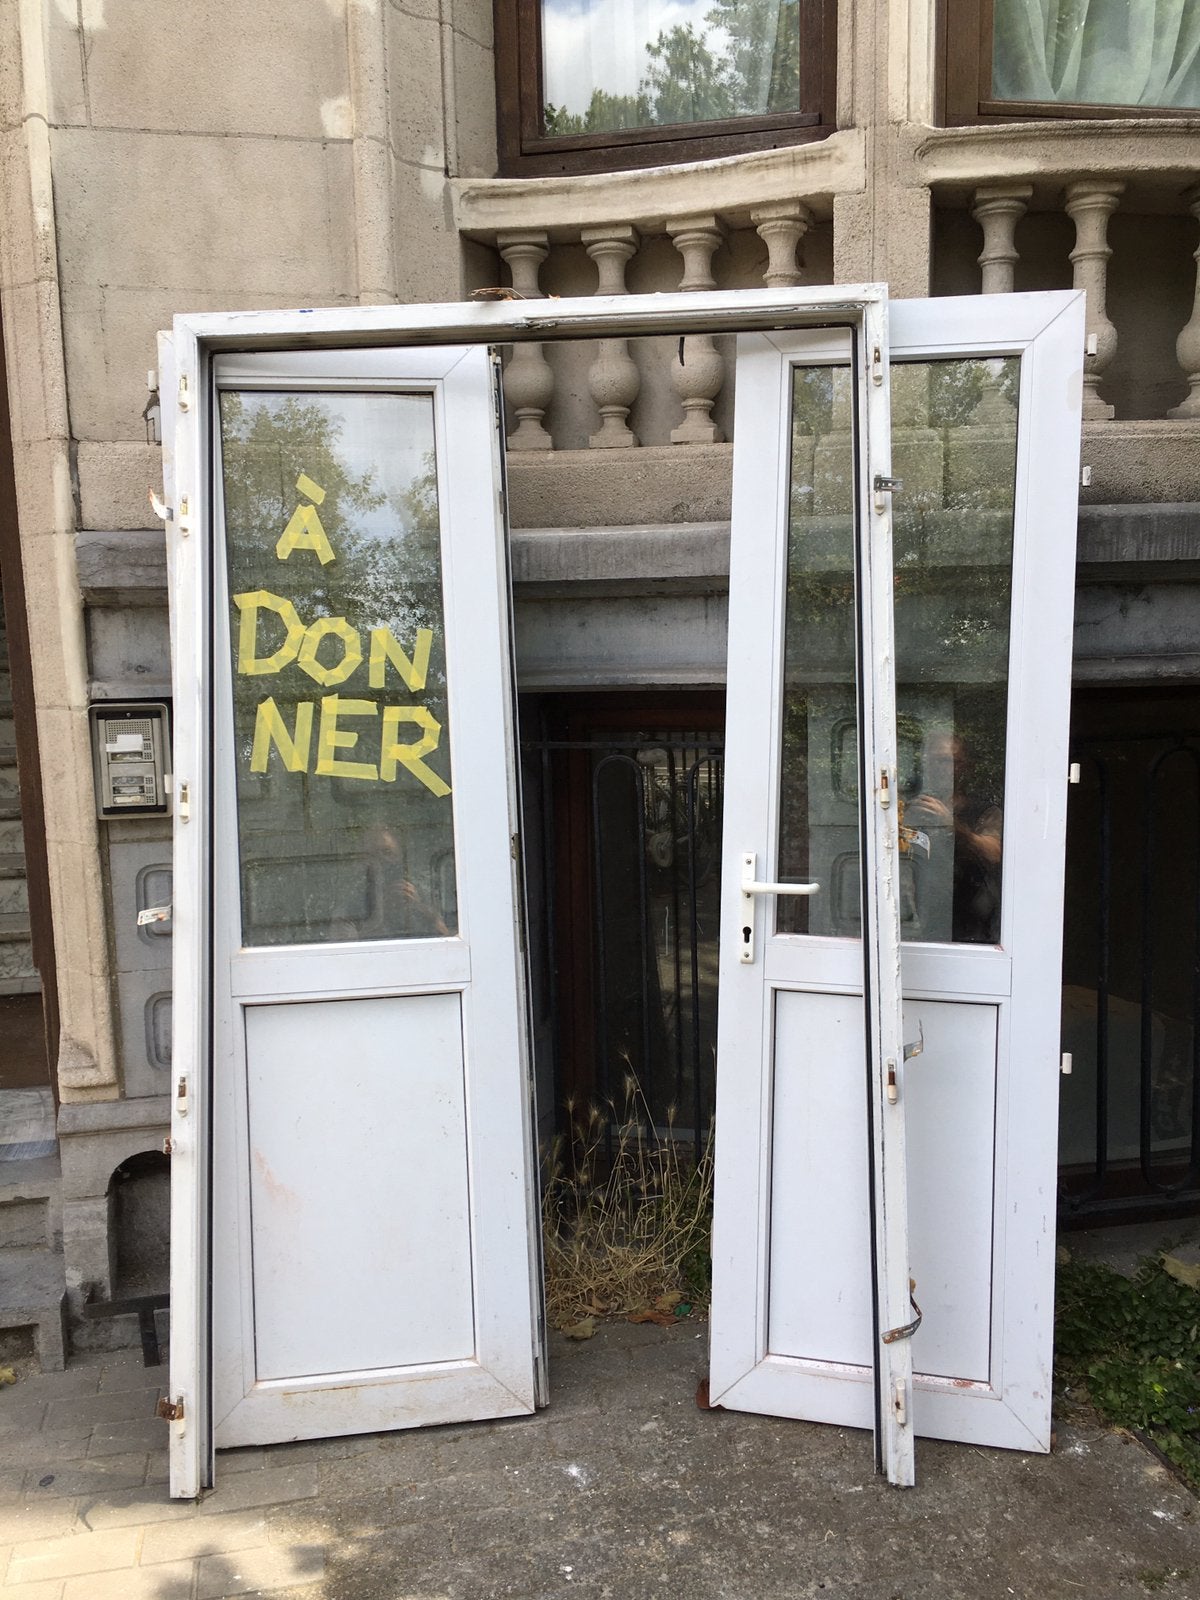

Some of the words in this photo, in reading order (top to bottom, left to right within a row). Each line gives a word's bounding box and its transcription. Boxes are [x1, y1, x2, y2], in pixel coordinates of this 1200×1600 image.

[275, 473, 336, 565] À
[233, 589, 433, 692] DON
[250, 693, 452, 798] NER
